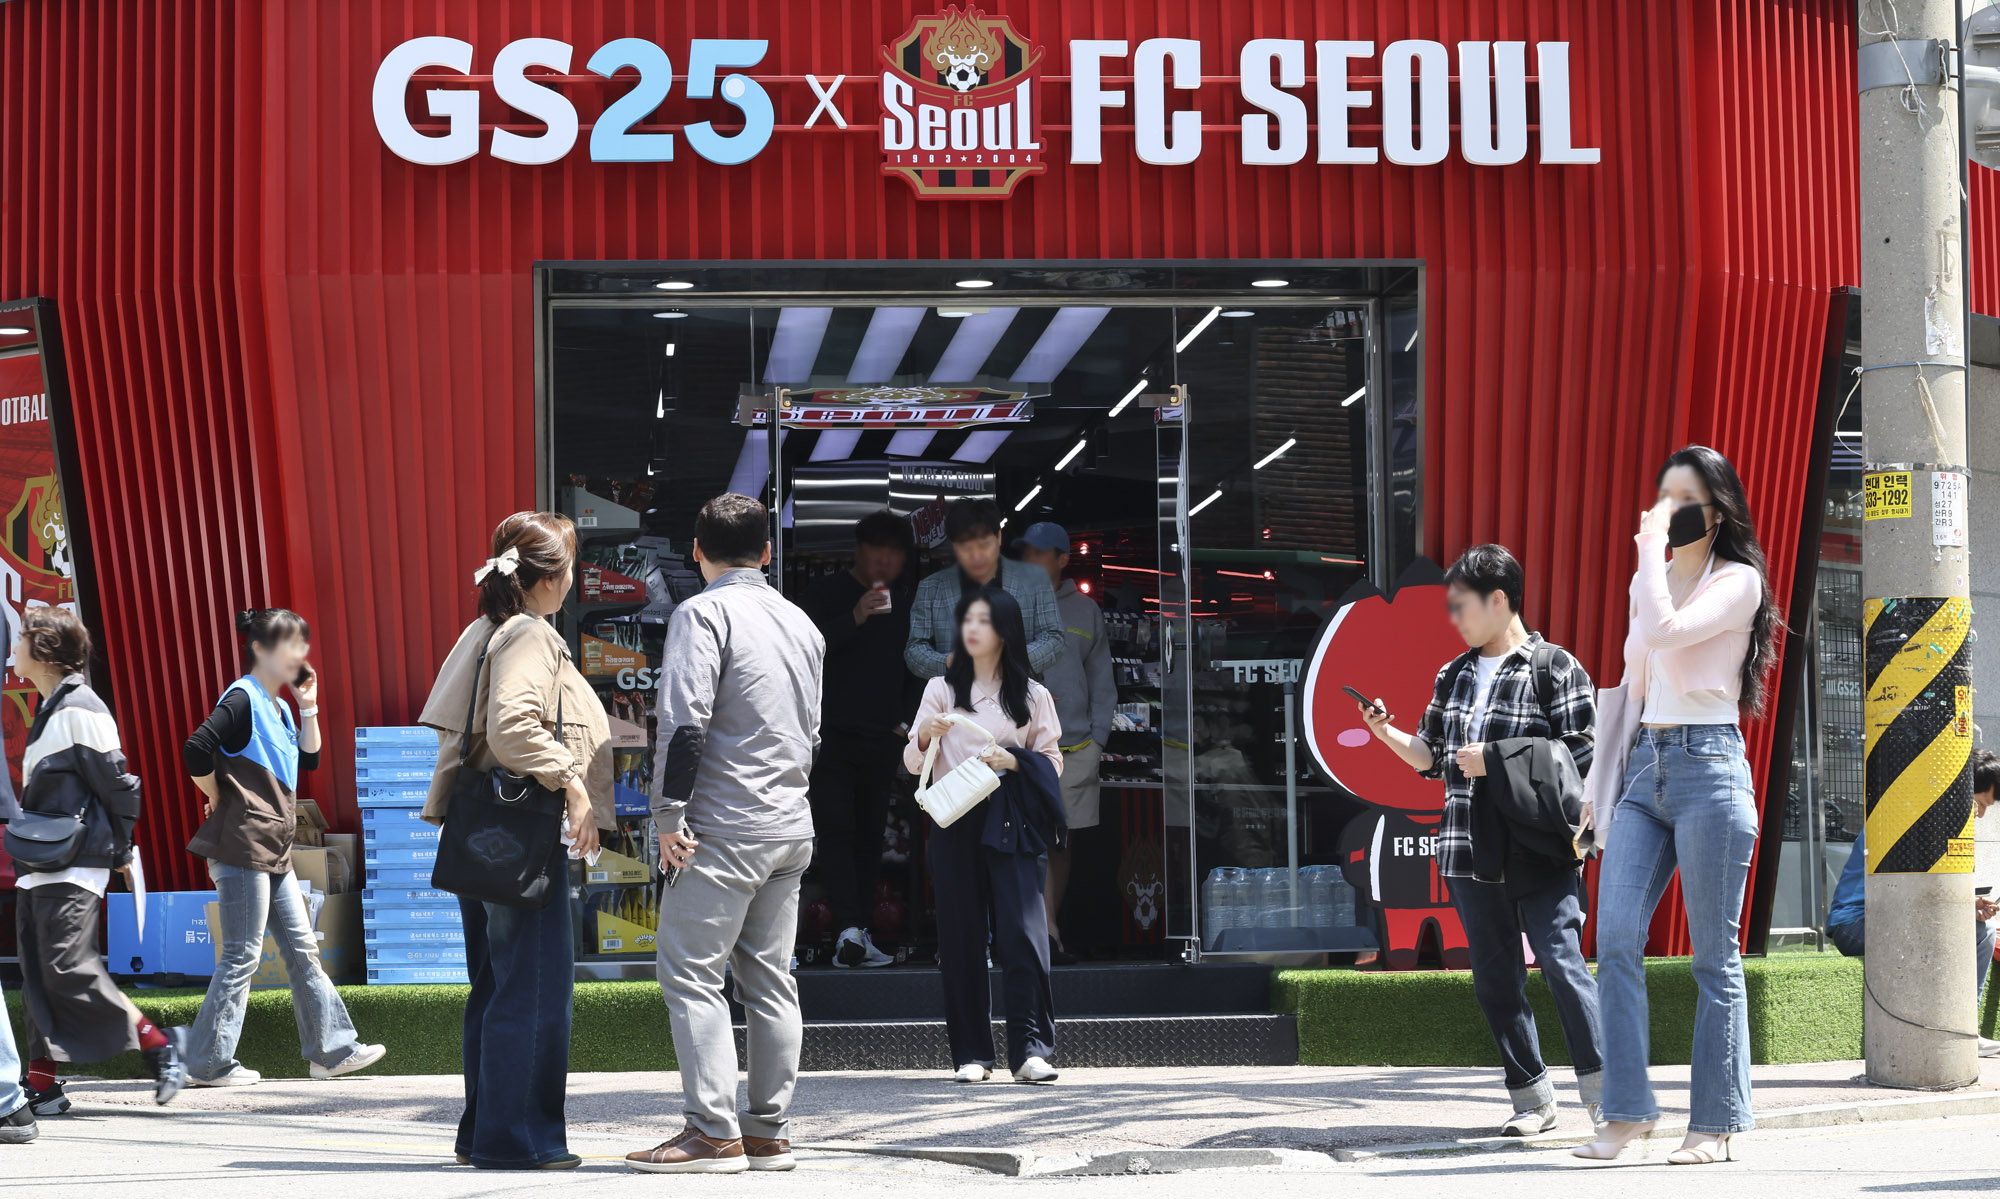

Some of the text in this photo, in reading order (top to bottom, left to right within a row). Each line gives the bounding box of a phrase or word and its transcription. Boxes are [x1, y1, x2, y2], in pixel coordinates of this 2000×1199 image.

[371, 35, 775, 165] GS25
[1069, 38, 1202, 166] FC
[1240, 38, 1601, 166] SEOUL
[953, 95, 973, 107] FC
[901, 465, 986, 491] WE ARE FC SEOUL
[1865, 475, 1908, 490] 현대 인력
[1865, 489, 1908, 508] 333-1292
[1234, 662, 1258, 683] FC
[1837, 680, 1860, 696] GS25
[1393, 837, 1414, 857] FC
